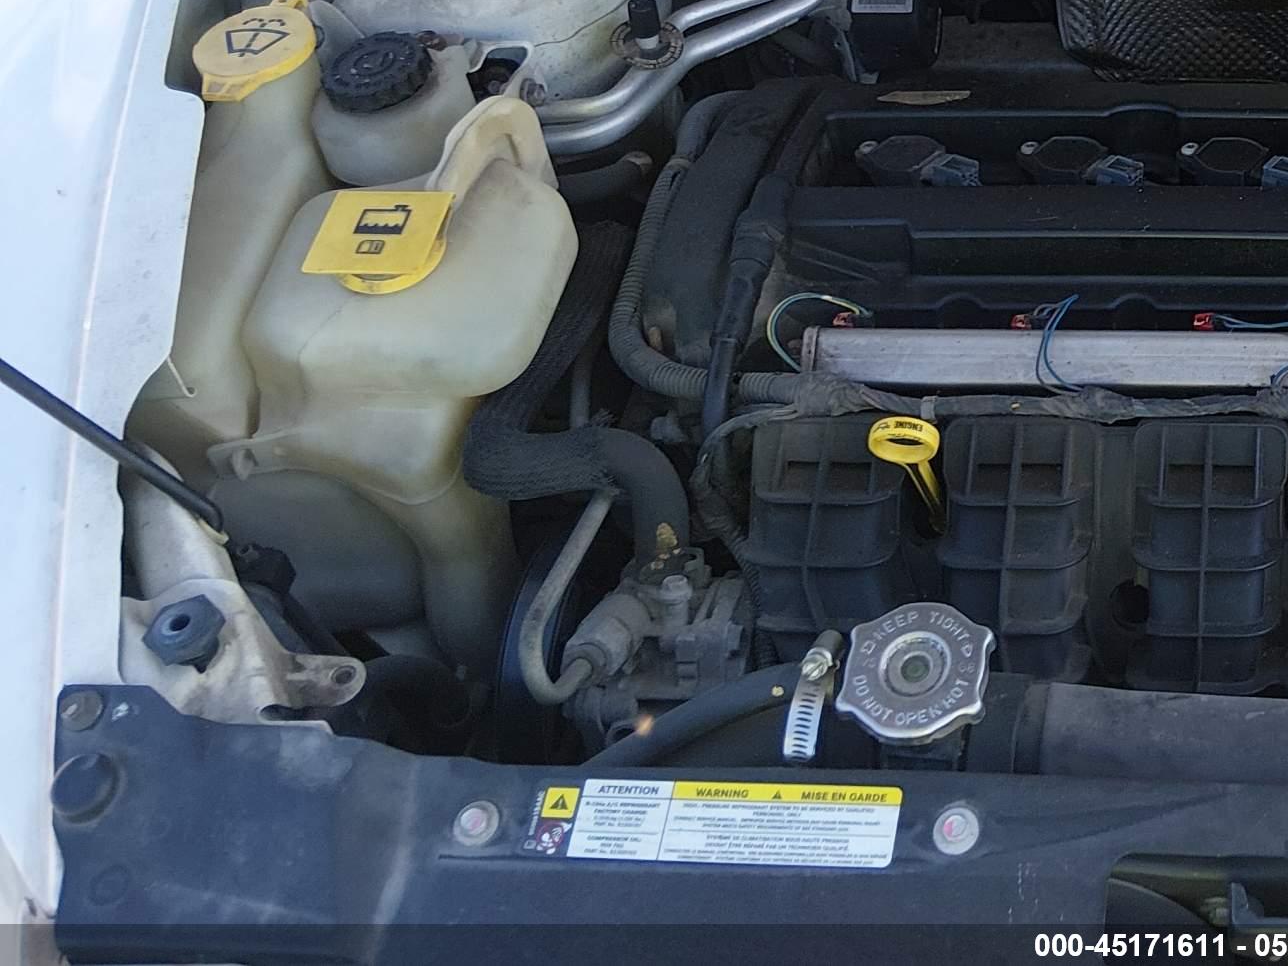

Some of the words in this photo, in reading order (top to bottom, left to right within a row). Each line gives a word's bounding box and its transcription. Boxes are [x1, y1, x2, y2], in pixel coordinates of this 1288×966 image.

[873, 611, 920, 641] KEEP
[929, 611, 971, 642] TIGHT
[853, 674, 870, 697] DO
[862, 696, 893, 722] NOT
[895, 704, 943, 726] OPEN
[943, 679, 969, 709] HOT
[597, 785, 660, 796] ATTENTION
[695, 787, 750, 799] WARNING
[801, 791, 829, 800] MISE
[831, 792, 846, 801] EN
[848, 792, 888, 802] GARDE
